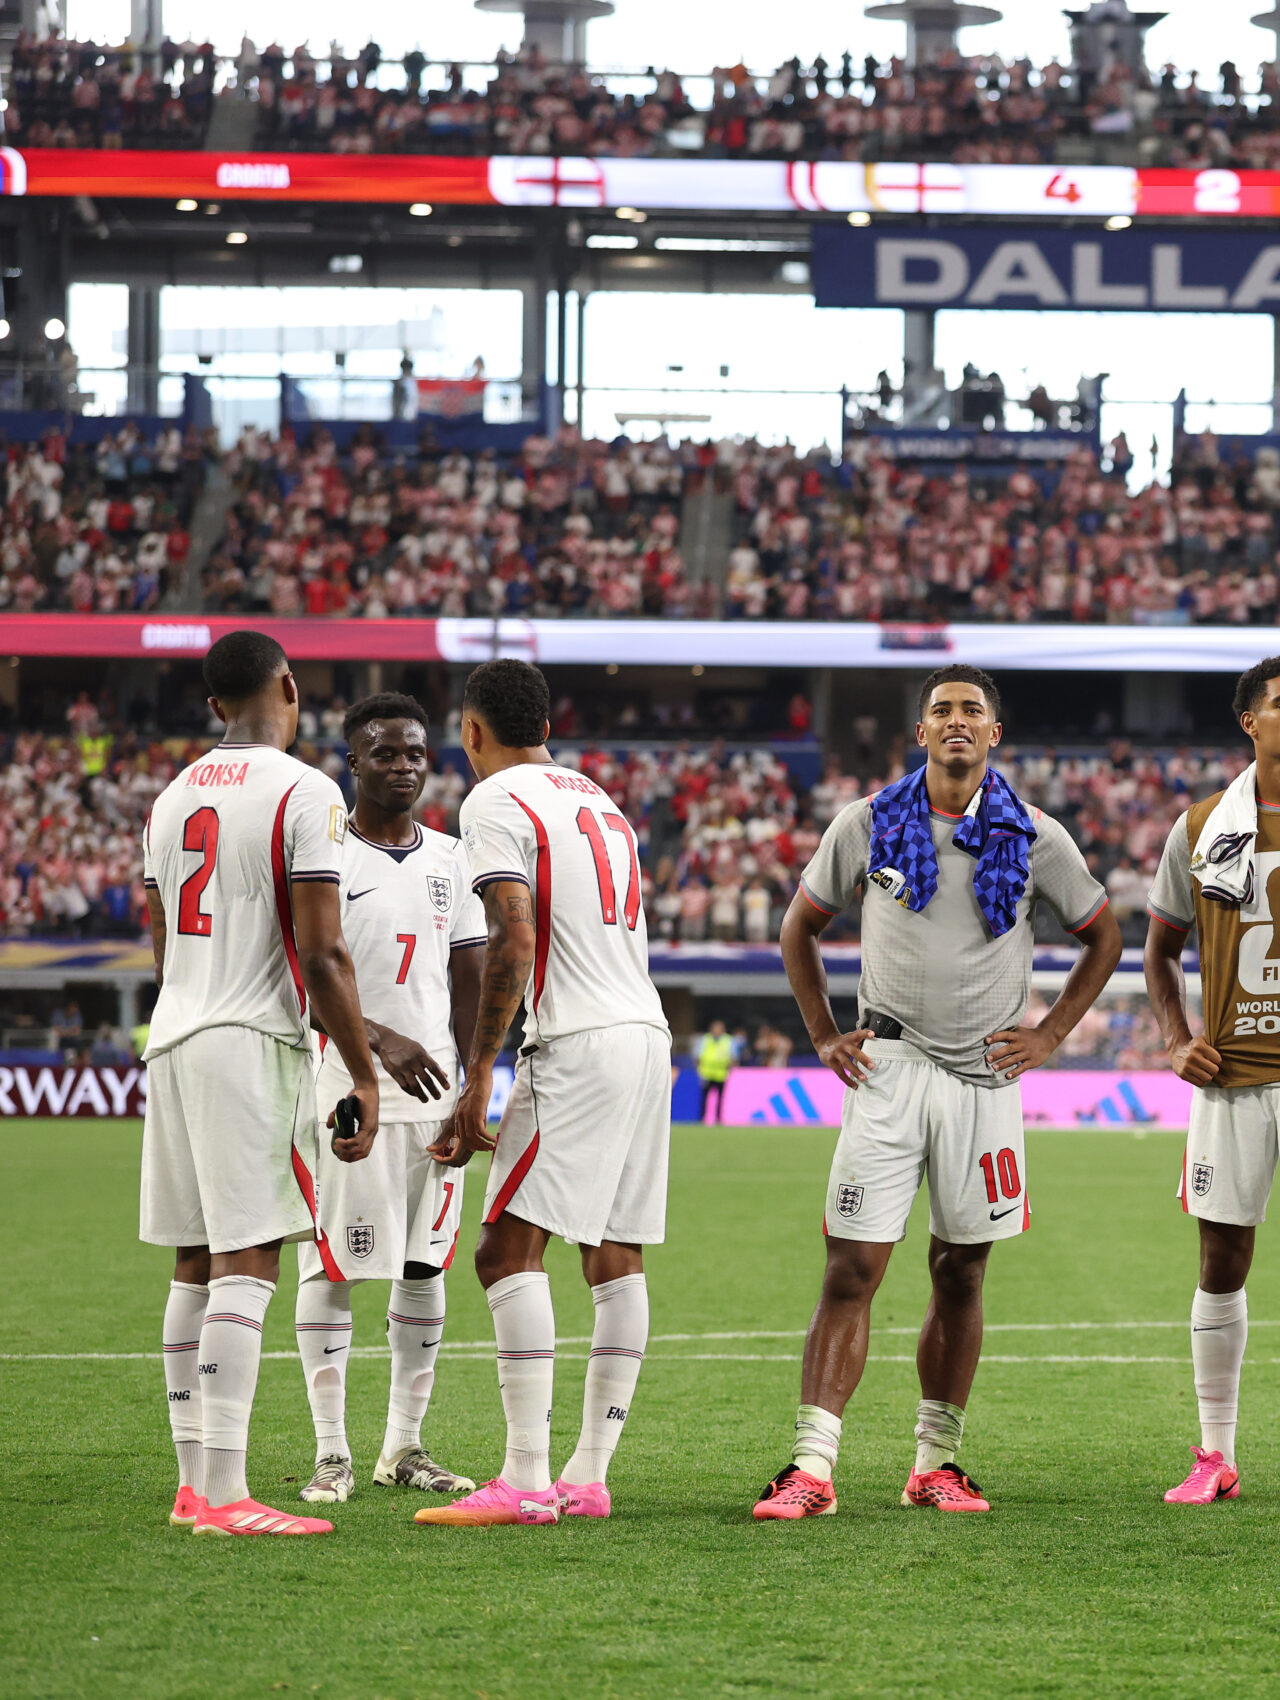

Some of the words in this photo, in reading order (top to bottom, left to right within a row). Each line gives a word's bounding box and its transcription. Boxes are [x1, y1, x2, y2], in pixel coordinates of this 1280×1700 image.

[1044, 171, 1083, 204] 4
[1193, 168, 1242, 213] 2
[185, 762, 250, 787] KONSA
[178, 806, 220, 938] 2
[575, 806, 640, 932] 17
[395, 933, 417, 985] 7
[978, 1147, 1022, 1204] 10
[432, 1181, 454, 1232] 7
[198, 1362, 218, 1375] ENG
[168, 1390, 191, 1401] ENG
[606, 1405, 628, 1422] ENG
